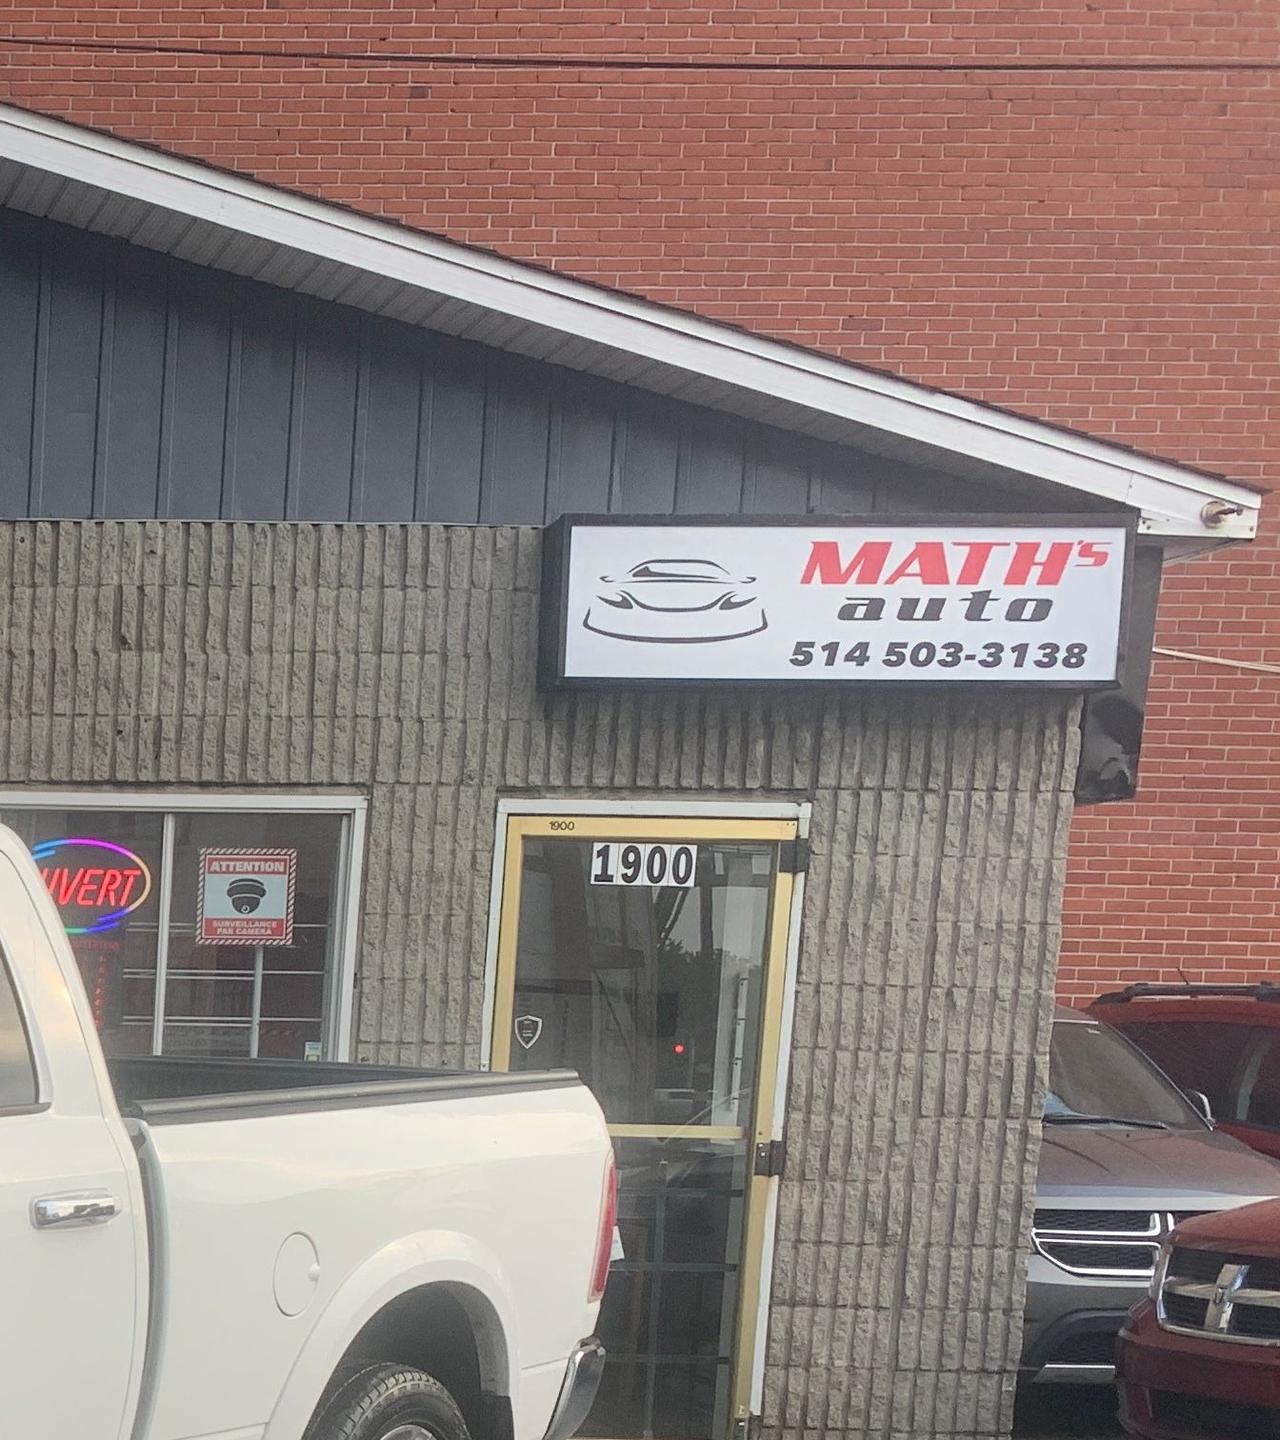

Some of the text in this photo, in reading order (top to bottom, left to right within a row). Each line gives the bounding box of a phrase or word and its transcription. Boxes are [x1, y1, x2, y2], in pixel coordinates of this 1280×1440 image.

[837, 590, 1054, 622] auto
[789, 642, 1088, 669] 514 503-3138
[549, 821, 575, 831] 1900
[209, 861, 285, 873] ATTENTION
[593, 844, 694, 885] 1900
[40, 868, 142, 907] VERT
[212, 920, 277, 928] SURVEILLANCE
